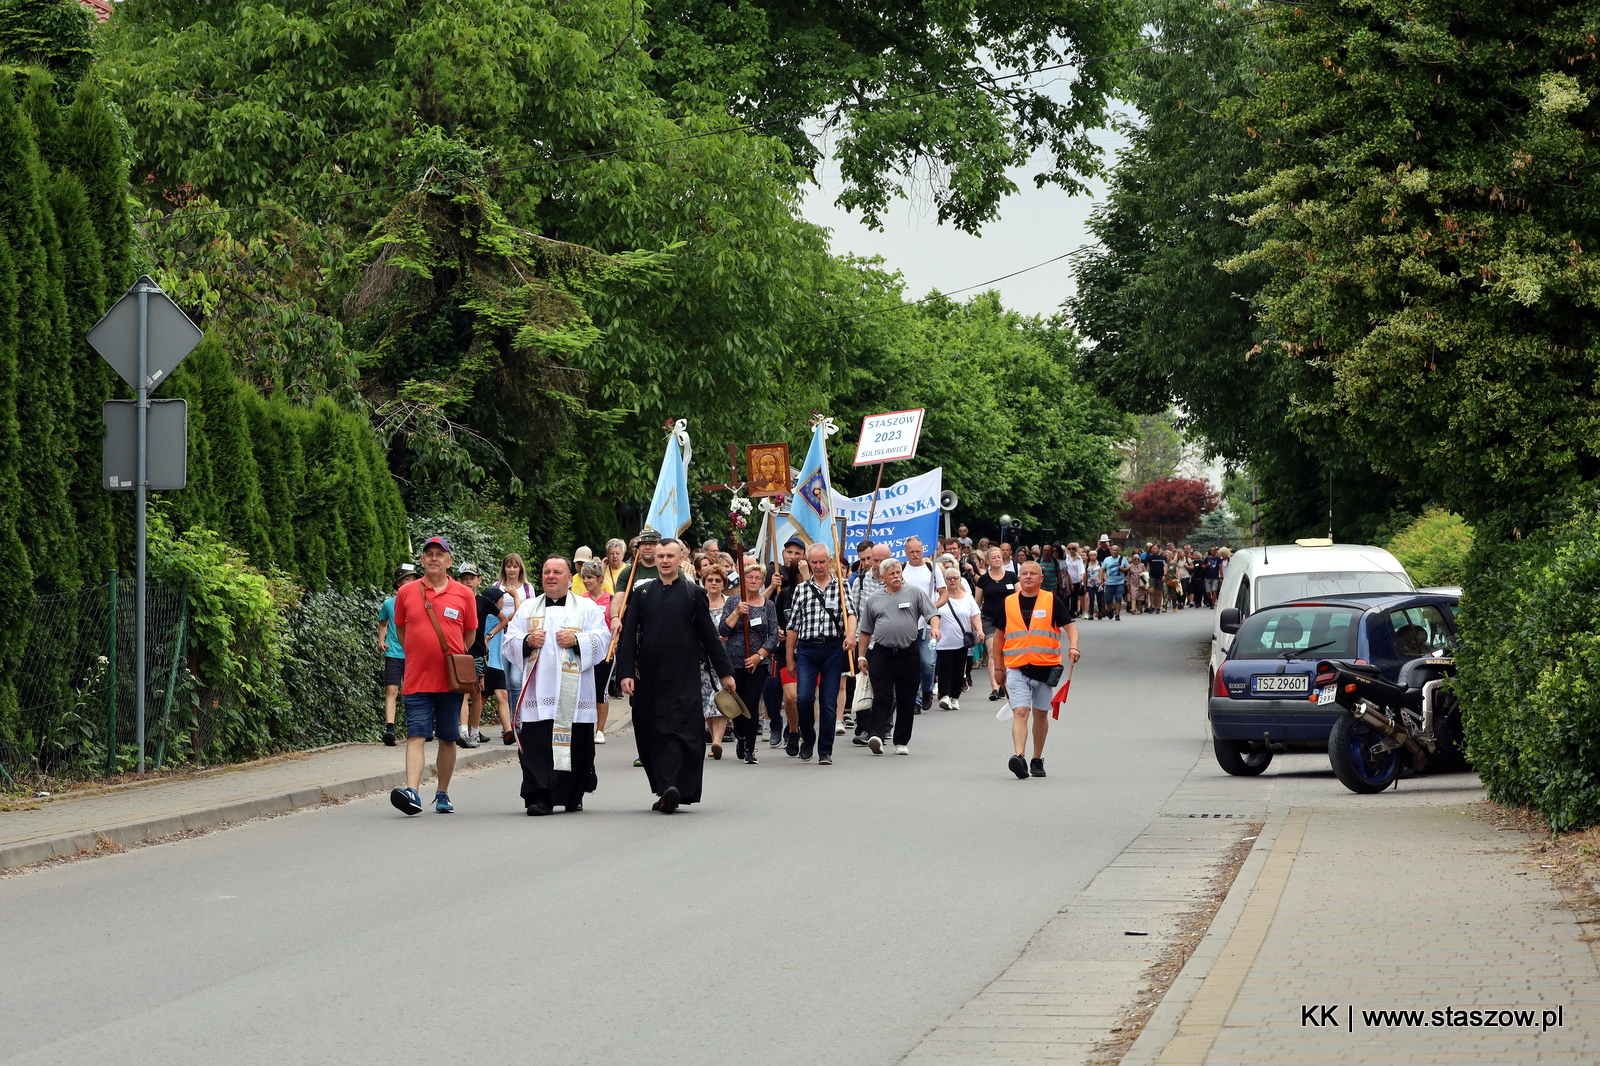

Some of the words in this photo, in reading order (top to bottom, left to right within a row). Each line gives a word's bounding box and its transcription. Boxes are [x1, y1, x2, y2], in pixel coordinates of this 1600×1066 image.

[868, 415, 915, 429] STASZÓW
[874, 430, 902, 443] 2023
[861, 445, 908, 457] SULISŁAWICE
[1258, 678, 1275, 690] TSZ
[1277, 678, 1306, 690] 29601
[554, 733, 571, 742] AVE
